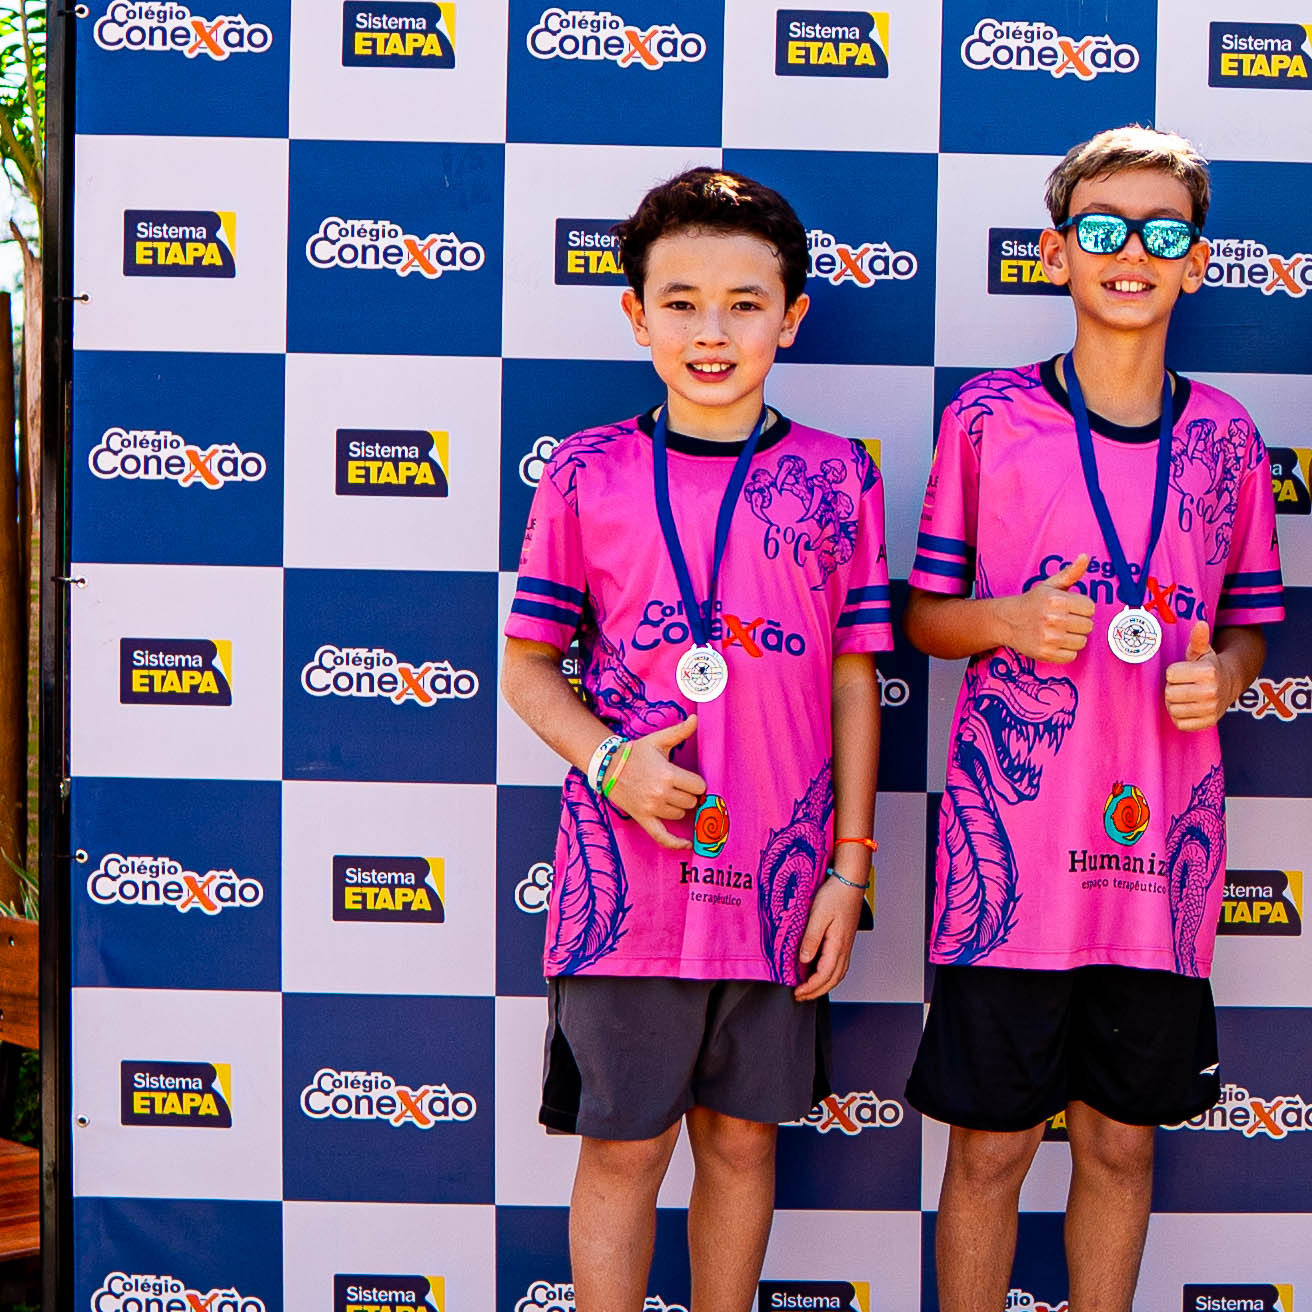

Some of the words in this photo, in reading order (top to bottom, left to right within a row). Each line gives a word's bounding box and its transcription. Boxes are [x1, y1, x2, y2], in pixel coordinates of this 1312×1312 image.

[110, 2, 186, 27] Colégio
[354, 11, 427, 31] Sistema
[542, 11, 619, 36] Colégio
[788, 21, 861, 40] Sistema
[976, 21, 1052, 46] Colégio
[1220, 33, 1292, 52] Sistema
[353, 31, 443, 57] ETAPA
[787, 40, 877, 66] ETAPA
[1219, 52, 1308, 78] ETAPA
[136, 221, 207, 240] Sistema
[322, 220, 399, 245] Colégio
[568, 230, 619, 249] Siste
[135, 240, 224, 266] ETAPA
[1001, 239, 1042, 258] Siste
[567, 249, 619, 274] ETA
[1000, 259, 1048, 284] ETA
[105, 430, 181, 455] Colégio
[348, 440, 420, 459] Sistema
[347, 459, 437, 485] ETAPA
[132, 649, 203, 668] Sistema
[317, 648, 394, 673] Colégio
[131, 668, 220, 694] ETAPA
[103, 857, 178, 881] Colégio
[345, 866, 416, 885] Sistema
[344, 885, 433, 911] ETAPA
[1221, 881, 1274, 898] stema
[1219, 899, 1289, 923] TAPA
[132, 1072, 203, 1091] Sistema
[316, 1072, 392, 1096] Colégio
[131, 1091, 219, 1117] ETAPA
[106, 1275, 181, 1299] Colégio
[345, 1285, 416, 1303] Sistema
[529, 1283, 574, 1307] Colé
[770, 1291, 841, 1309] Sistema
[1194, 1294, 1264, 1311] Sistema
